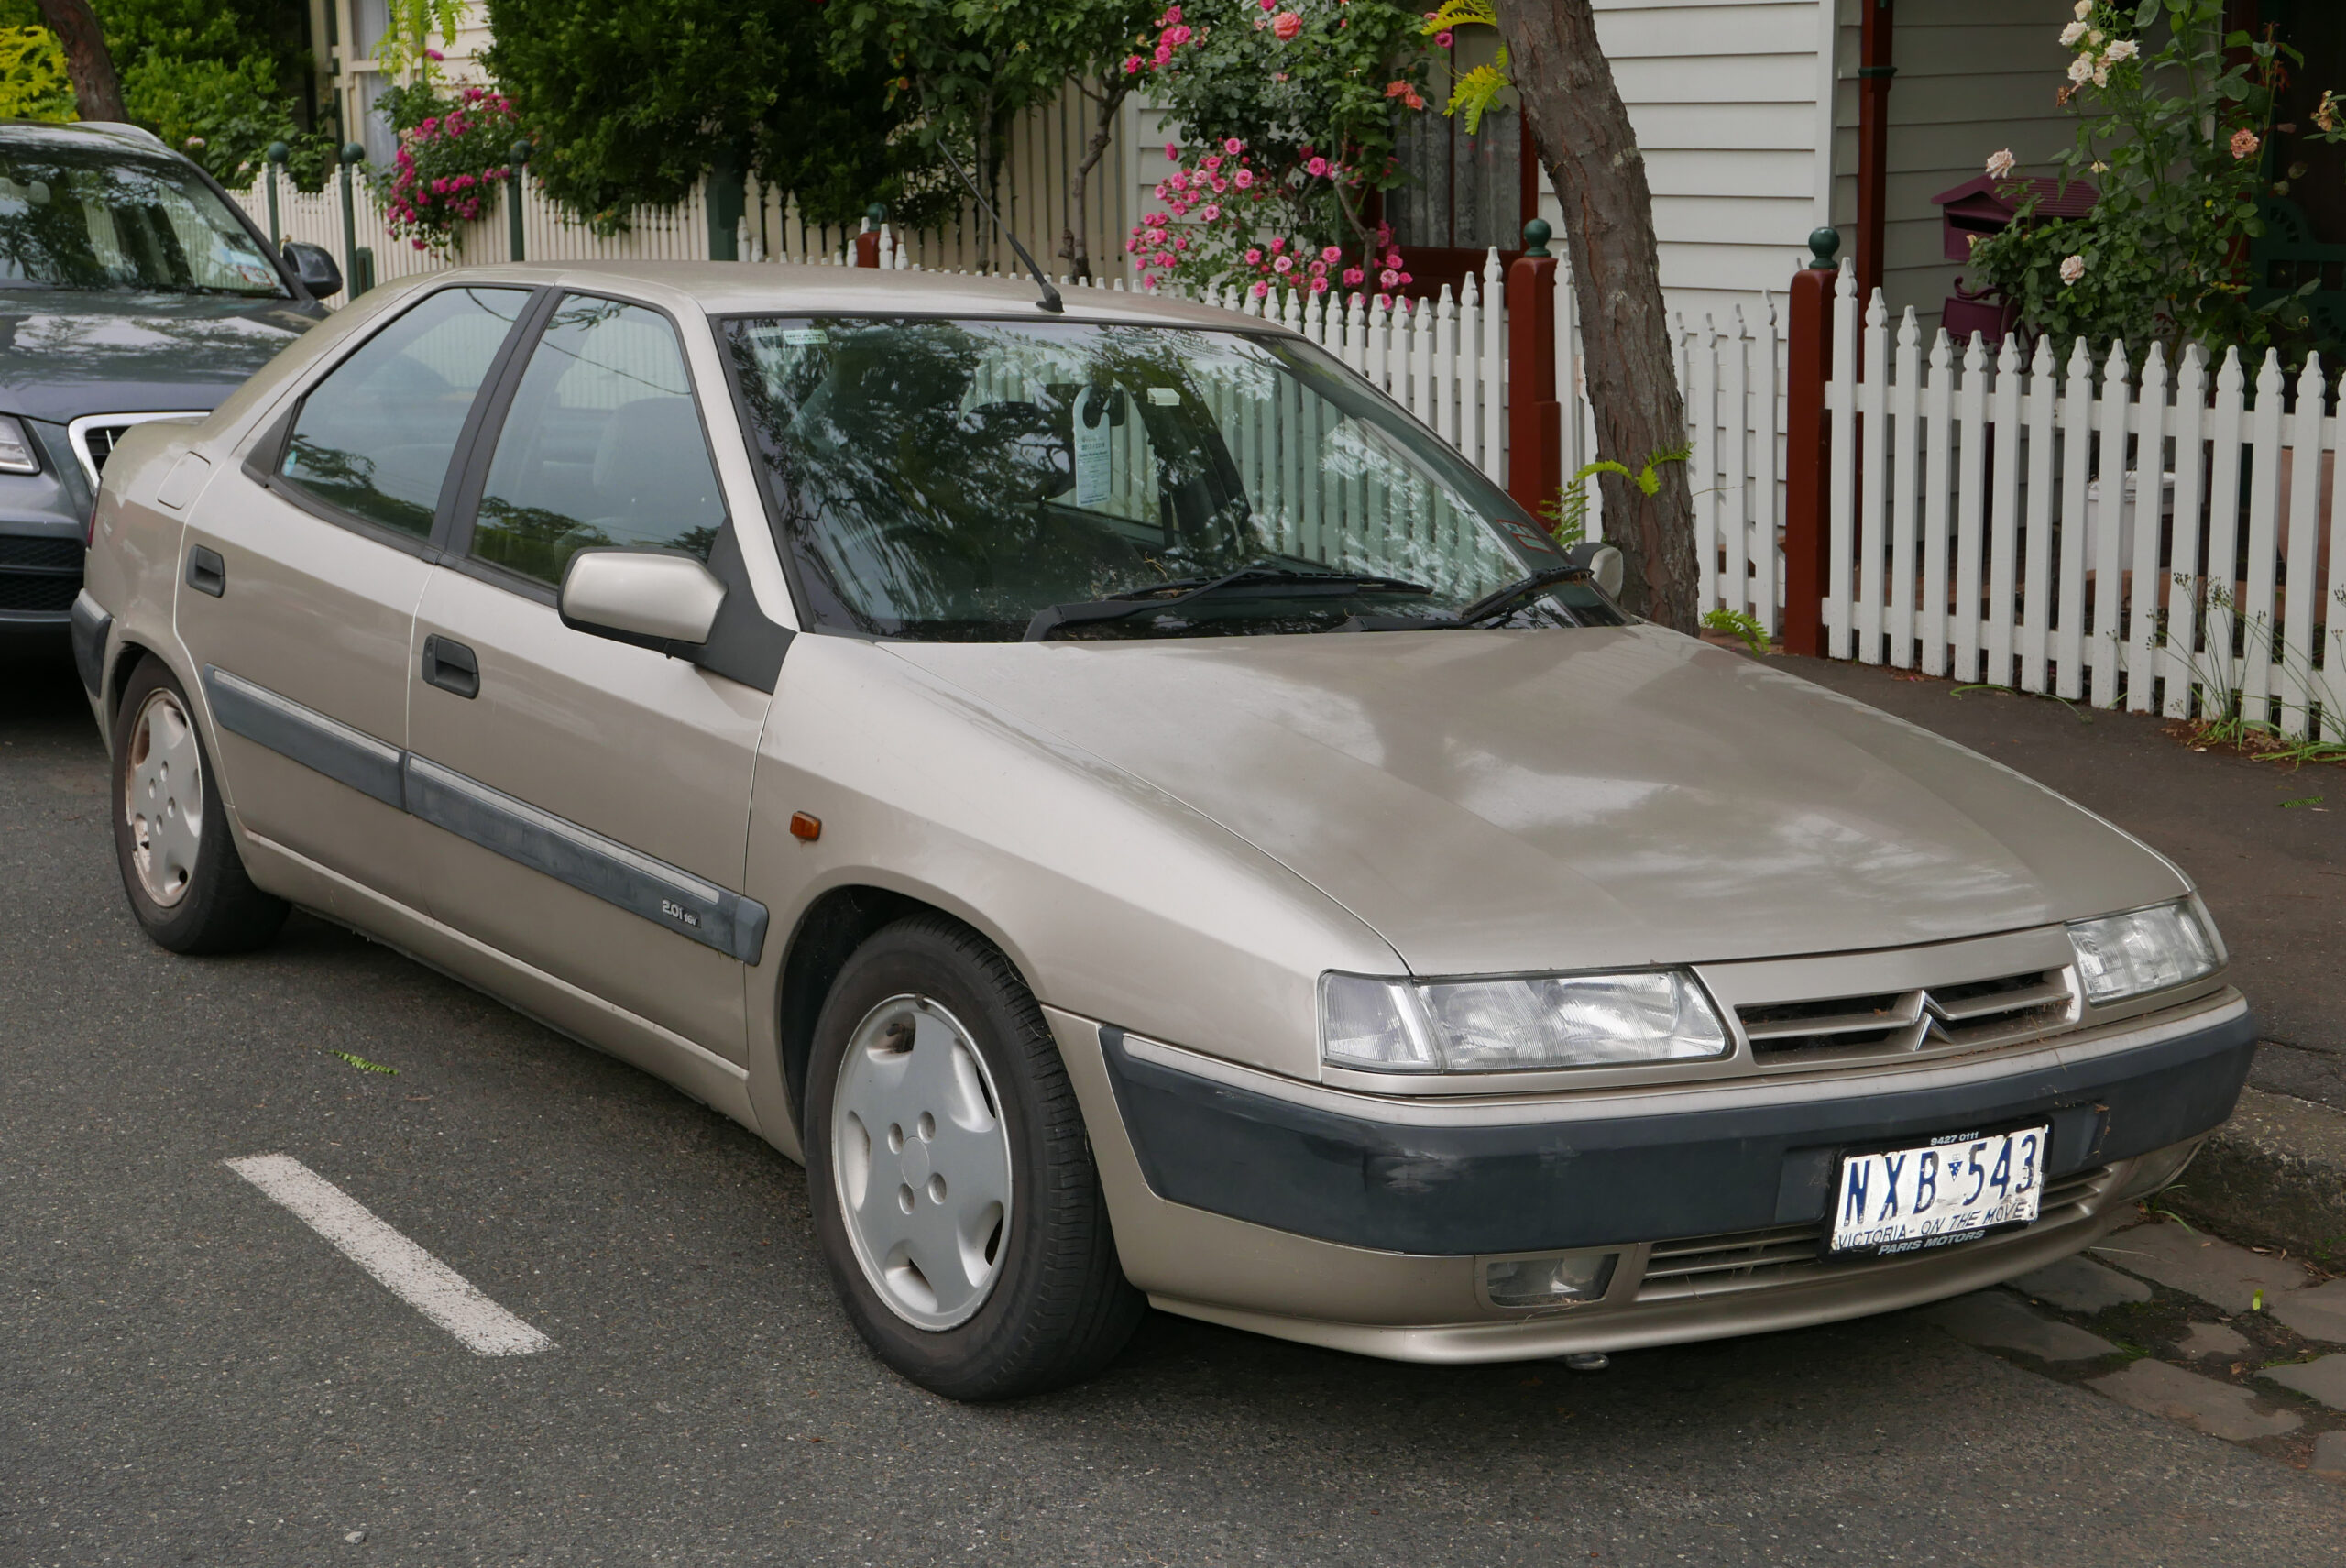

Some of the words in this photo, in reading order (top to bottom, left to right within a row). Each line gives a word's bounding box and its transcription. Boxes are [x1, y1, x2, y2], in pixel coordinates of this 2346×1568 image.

[1930, 1135, 1957, 1146] 9427
[1959, 1131, 1979, 1142] 0111
[1843, 1150, 1939, 1226] NXB
[1962, 1134, 2037, 1206] 543
[1920, 1215, 1946, 1235] ON
[1948, 1212, 1979, 1232] THE
[1982, 1201, 2028, 1225] MOVE
[1878, 1240, 1922, 1255] PARIS
[1924, 1230, 1986, 1247] MOTORS
